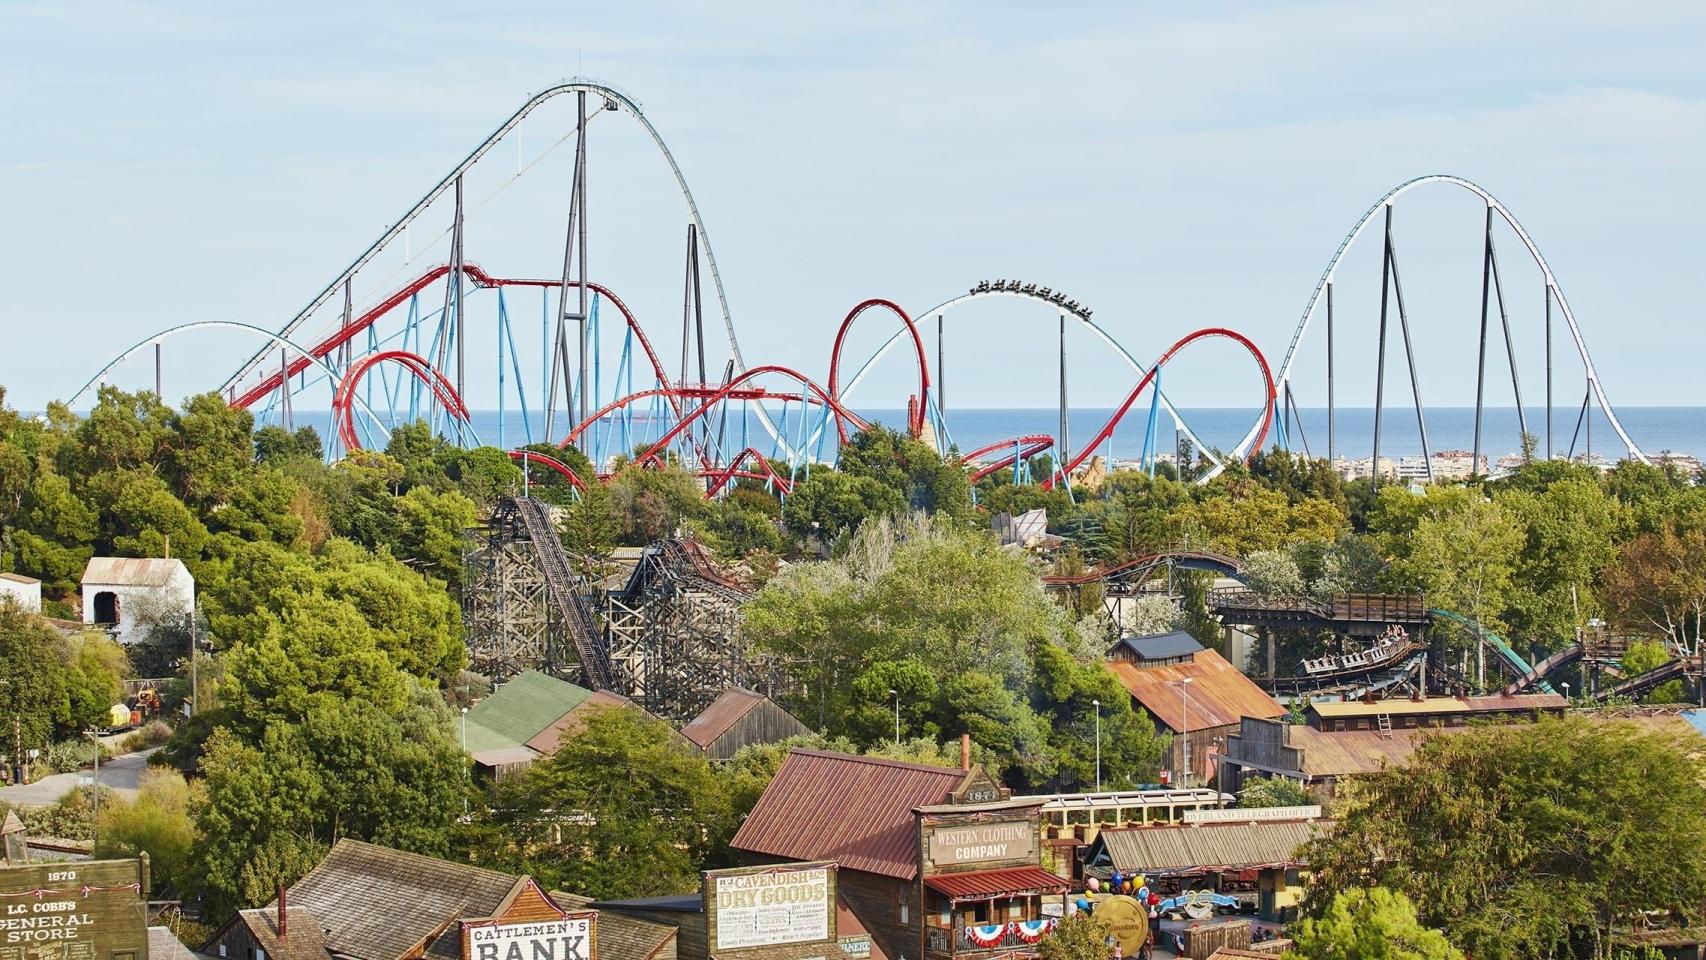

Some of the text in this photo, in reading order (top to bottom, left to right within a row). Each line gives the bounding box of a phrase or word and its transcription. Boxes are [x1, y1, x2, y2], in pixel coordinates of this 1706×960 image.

[937, 825, 1026, 846] WESTERN CLOTHING
[955, 844, 1008, 860] COMPANY
[47, 871, 76, 881] 1870
[735, 870, 808, 889] CAVENDISH
[718, 883, 825, 909] DRY GOODS
[32, 901, 76, 913] COBB'S
[7, 927, 78, 943] STORE
[474, 922, 586, 940] CATTLEMEN'S
